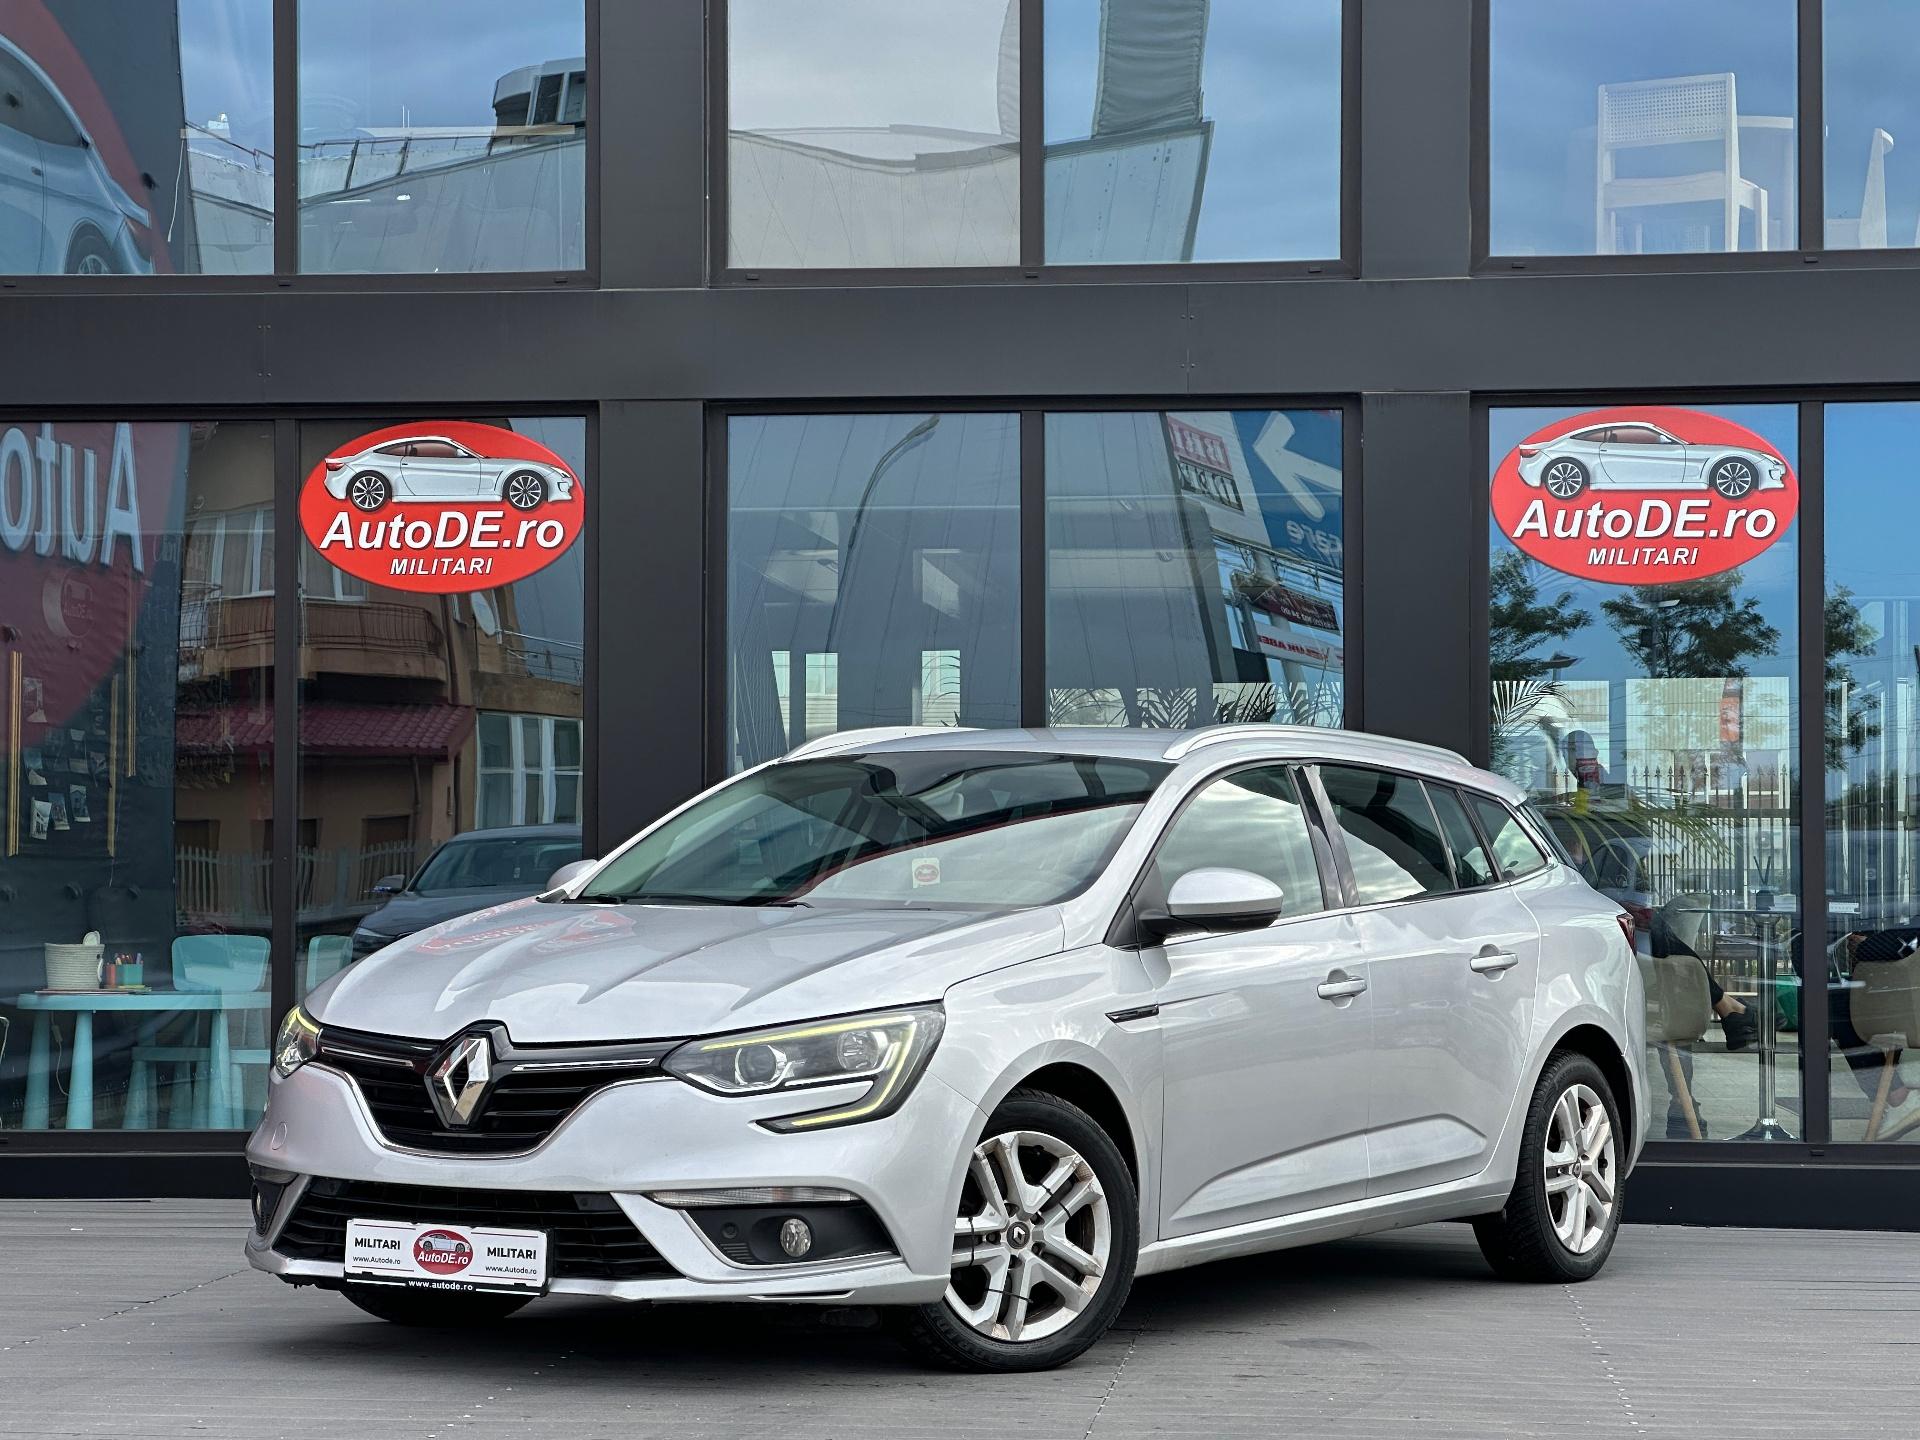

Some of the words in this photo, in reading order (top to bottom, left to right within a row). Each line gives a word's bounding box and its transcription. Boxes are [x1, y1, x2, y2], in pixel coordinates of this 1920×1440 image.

[1511, 498, 1777, 539] AutoDE.ro
[319, 510, 565, 550] AutoDE.ro
[1587, 547, 1699, 565] MILITARI
[389, 557, 493, 576] MILITARI
[354, 1237, 400, 1250] MILITARI
[417, 1250, 469, 1265] AutoDE.ro
[486, 1246, 537, 1260] MILITARI
[352, 1256, 401, 1265] www.Autode.ro
[485, 1266, 537, 1275] www.Autode.ro
[408, 1280, 473, 1291] www.autode.ro
